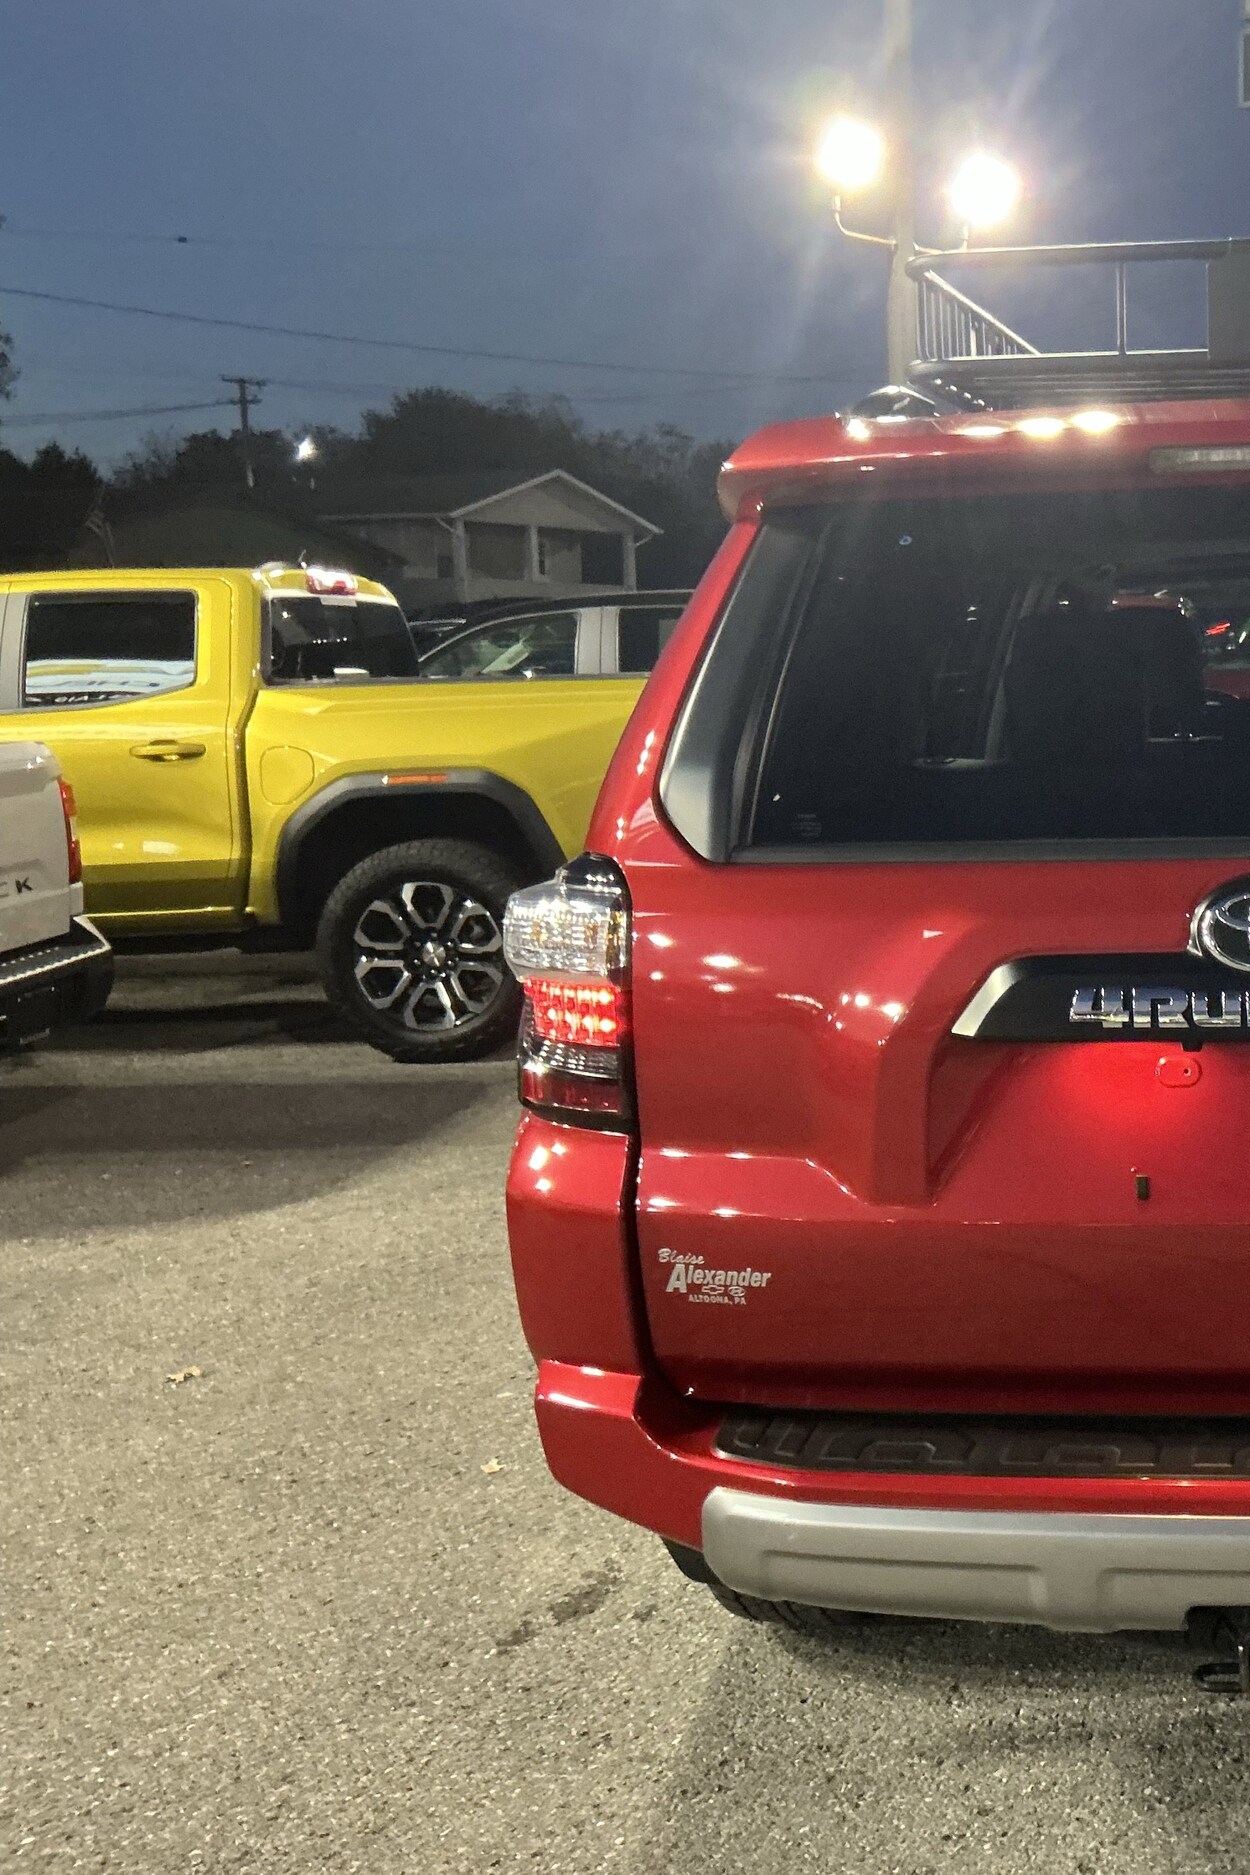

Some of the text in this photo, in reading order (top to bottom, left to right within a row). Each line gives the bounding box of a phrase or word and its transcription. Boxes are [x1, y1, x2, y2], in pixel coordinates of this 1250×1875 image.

[657, 1248, 705, 1265] Blaise
[666, 1263, 772, 1293] Alexander
[688, 1294, 747, 1305] ALTOONA, PA
